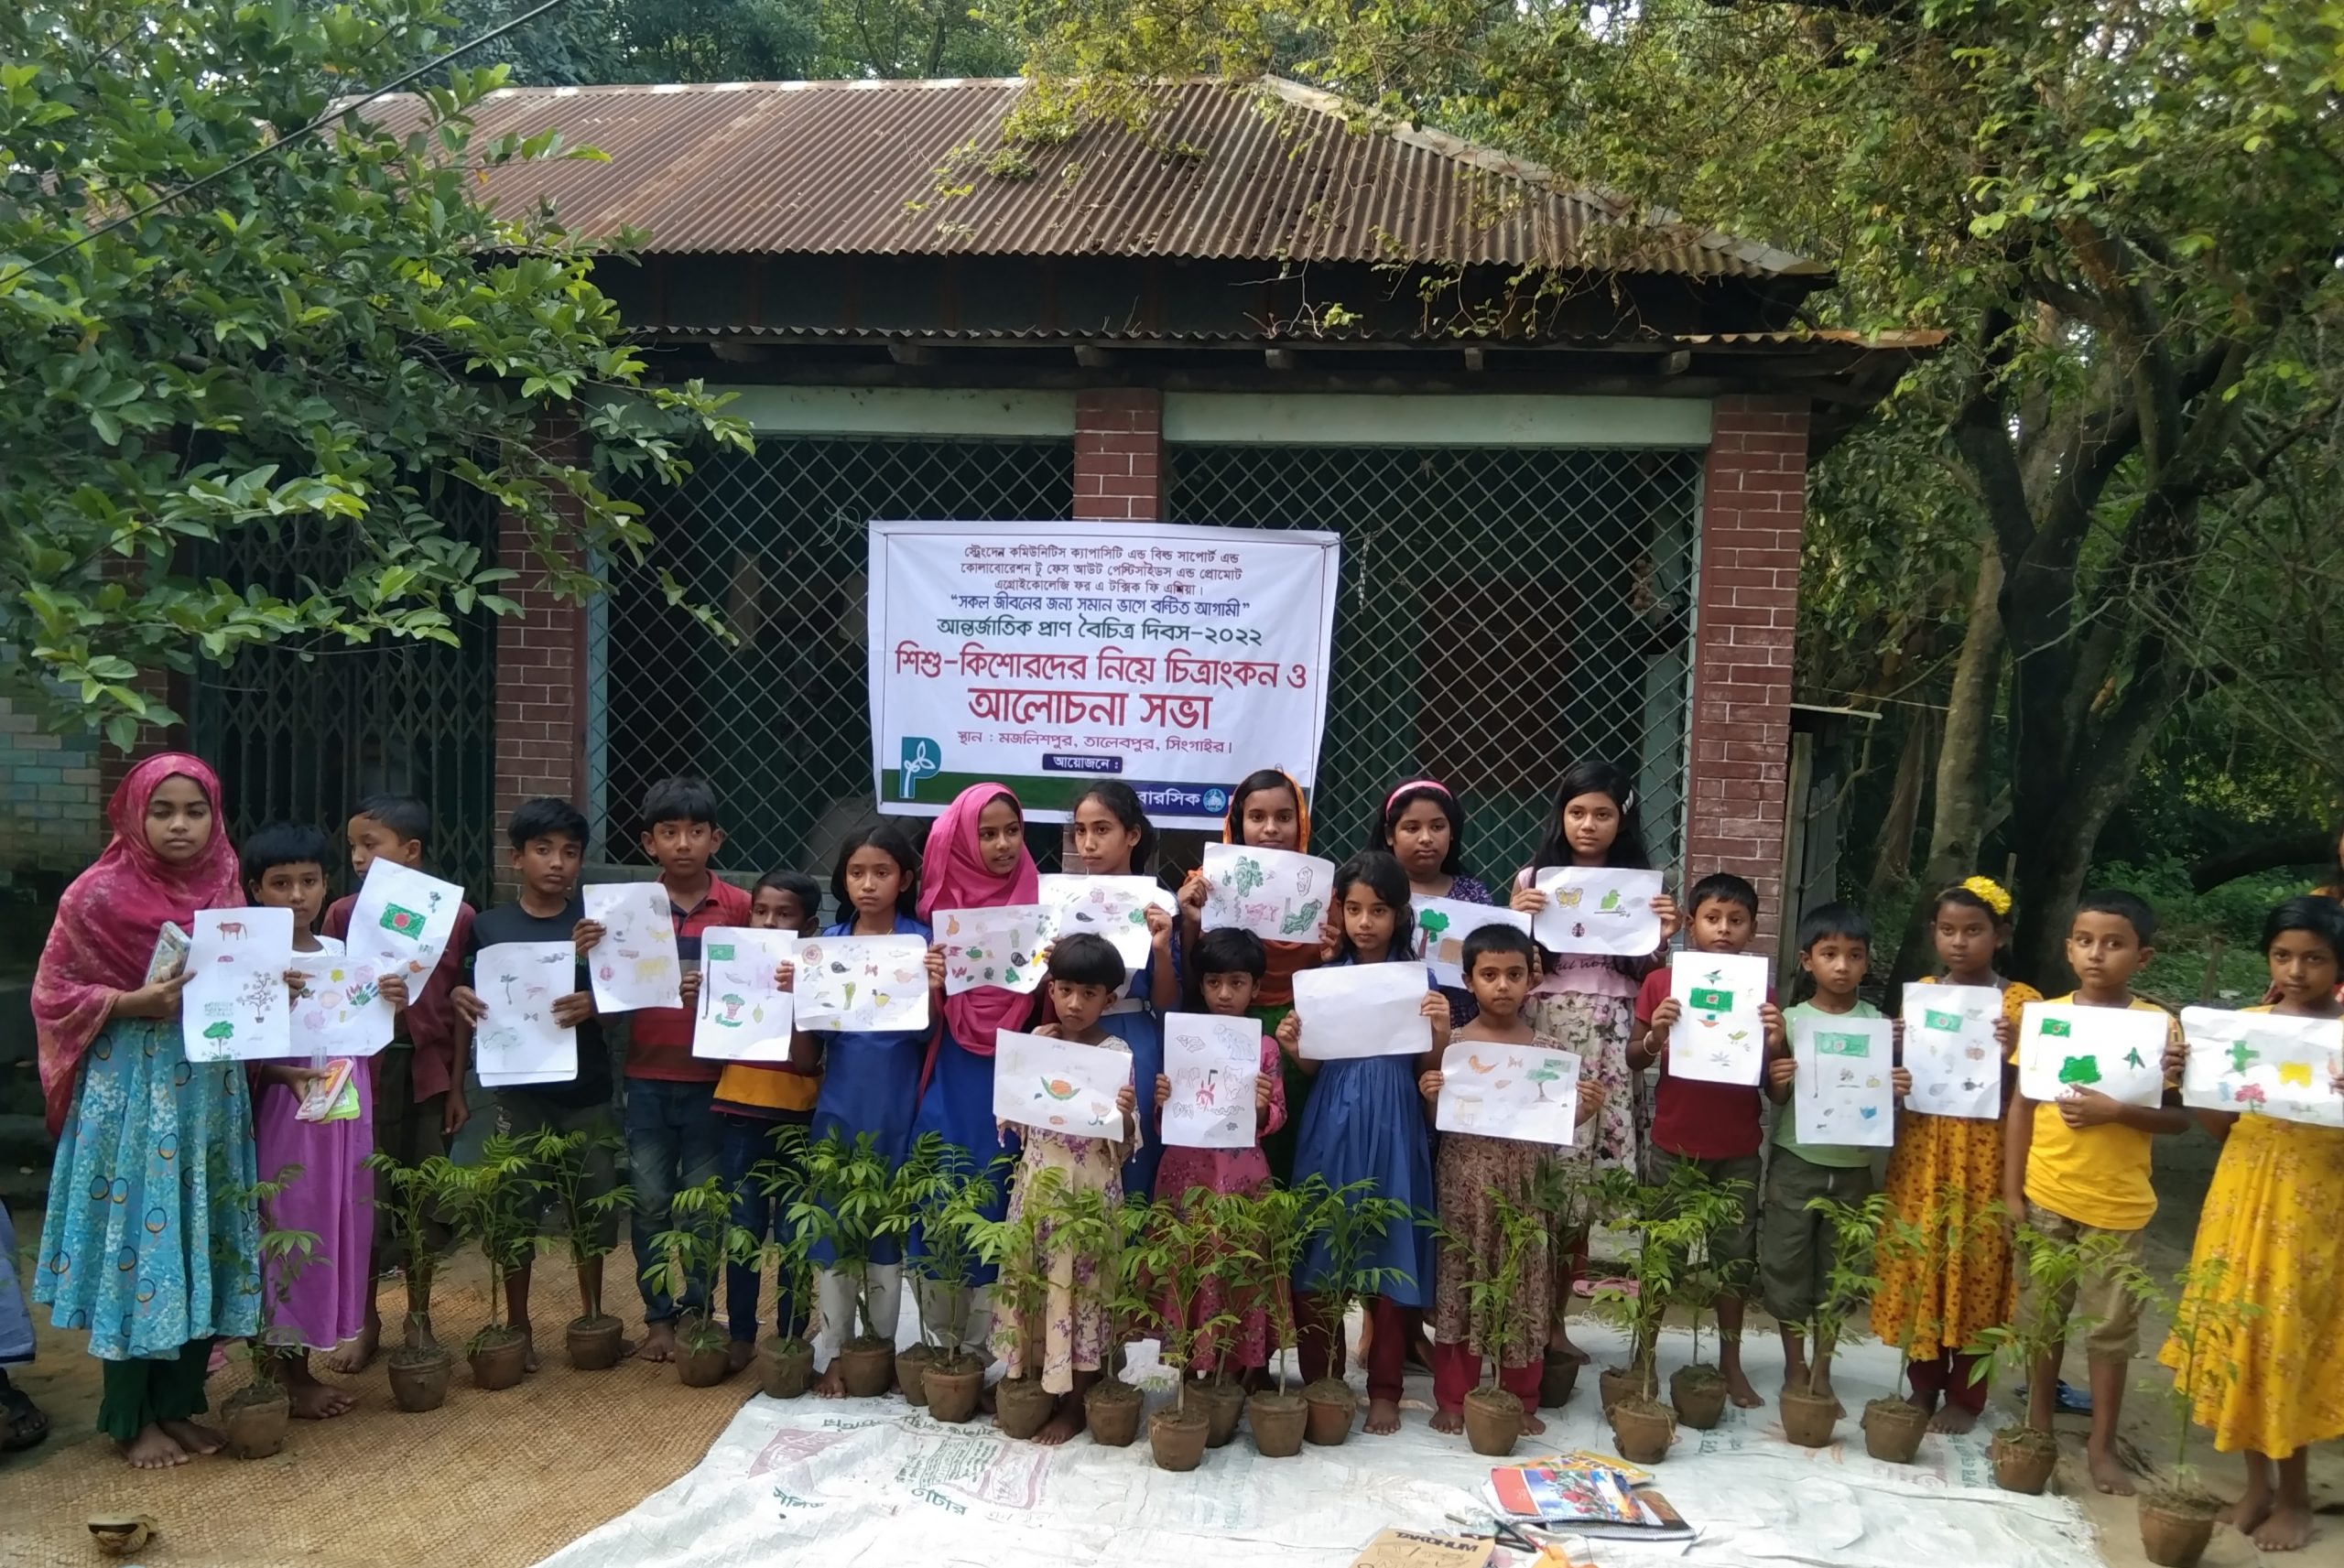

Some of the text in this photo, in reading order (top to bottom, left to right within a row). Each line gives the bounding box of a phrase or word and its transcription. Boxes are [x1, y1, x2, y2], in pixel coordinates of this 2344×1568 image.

[1010, 544, 1066, 558] কমিউনিটিস
[1070, 545, 1123, 559] ক্যাপাসিটি
[1128, 549, 1146, 560] এন্ড
[1177, 548, 1218, 563] সাপোর্ট
[1220, 553, 1240, 564] এন্ড
[960, 562, 1032, 576] কোলাবোরেশন
[1035, 561, 1043, 578] টু
[1047, 564, 1069, 576] ফেস
[1074, 561, 1103, 576] আউট
[1176, 568, 1195, 579] এন্ড
[1199, 567, 1243, 581] প্রোমোট
[1073, 580, 1091, 592] ফর
[1095, 581, 1104, 591] এ
[1109, 579, 1141, 593] টক্সিক
[1145, 579, 1160, 594] ফি
[993, 590, 1042, 611] জীবনের
[1046, 597, 1073, 611] জন্য
[1077, 598, 1112, 611] সমান
[1117, 599, 1146, 613] ভাগে
[937, 614, 1033, 637] আন্তর্জাতিক
[1037, 622, 1072, 637] প্রাণ
[1079, 612, 1135, 640] বৈচিত্র
[895, 640, 1307, 690] শিশু-কিশোরদের নিয়ে চিত্রাংকন ও
[968, 687, 1214, 730] আলোচনা সভা
[957, 730, 982, 746] স্থান
[1053, 756, 1111, 771] আয়োজনে
